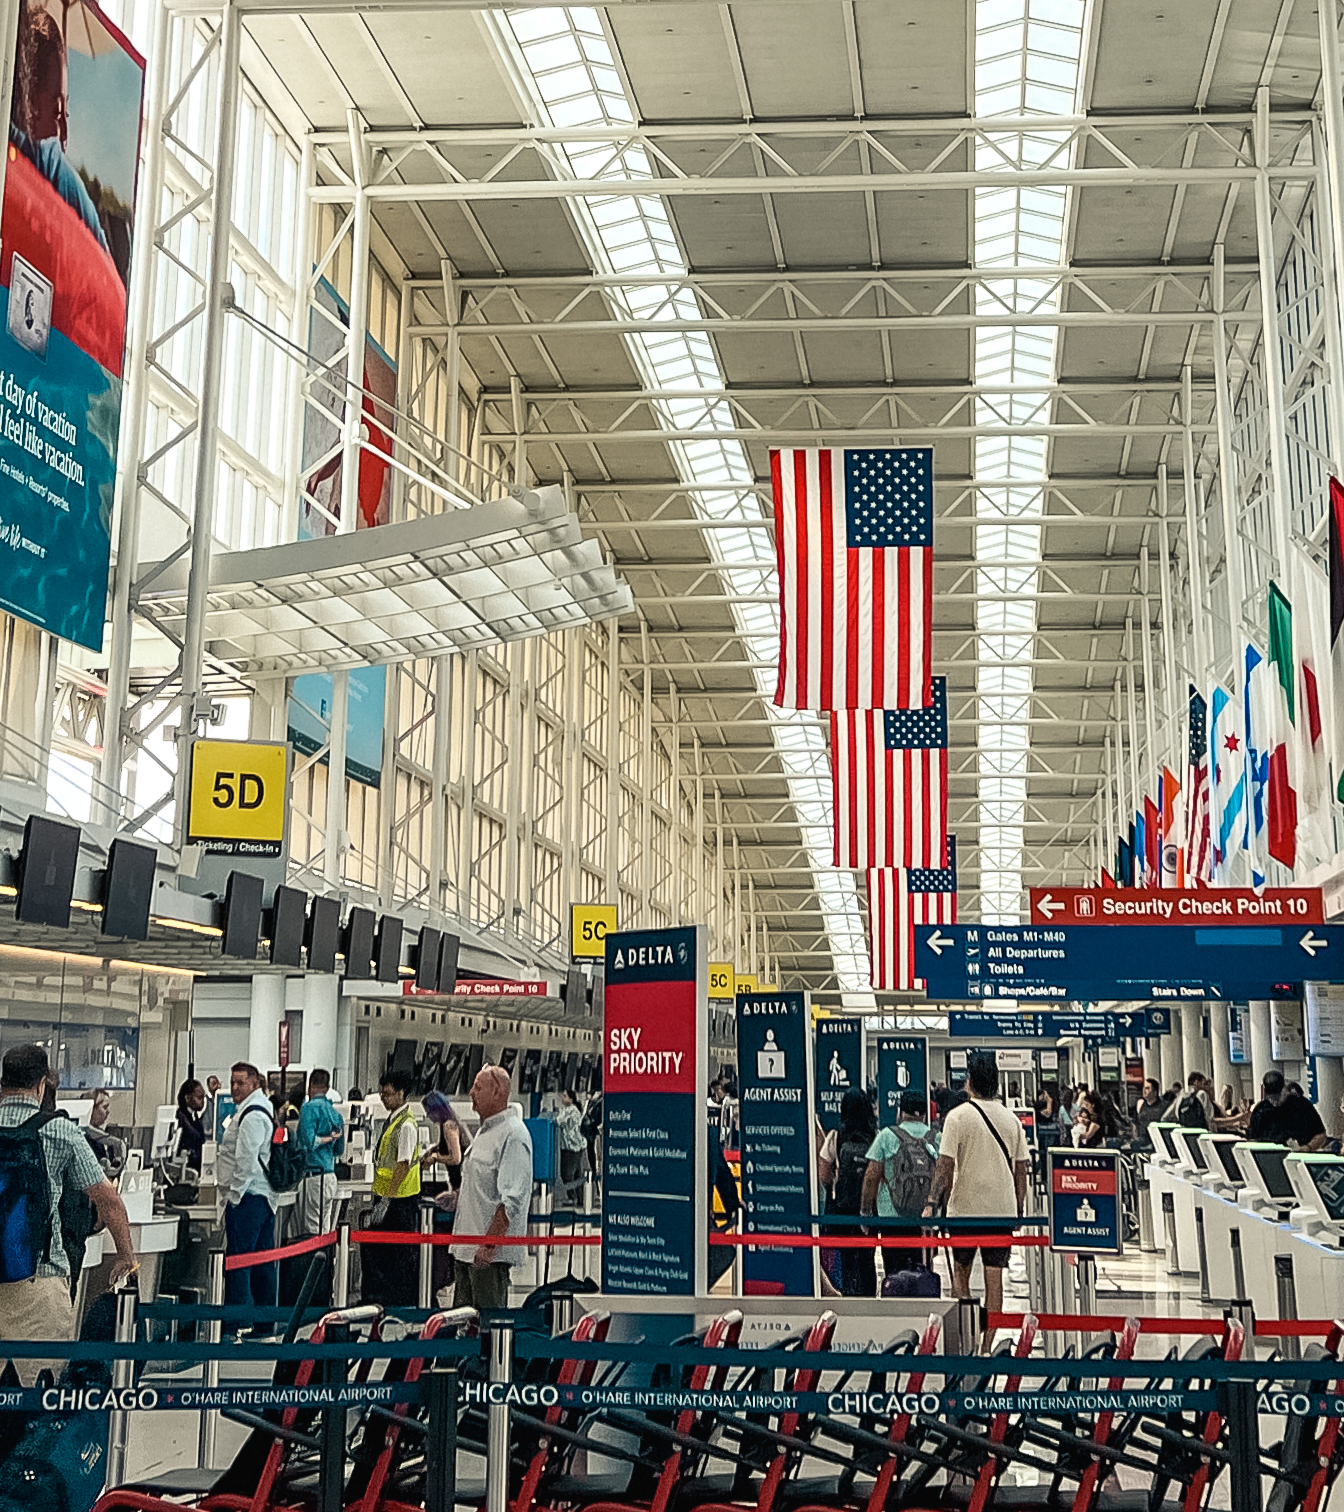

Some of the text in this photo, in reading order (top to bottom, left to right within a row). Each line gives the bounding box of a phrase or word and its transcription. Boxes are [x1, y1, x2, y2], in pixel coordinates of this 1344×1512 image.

[6, 374, 26, 414] day
[25, 391, 38, 418] of
[37, 401, 77, 446] vacation
[4, 409, 24, 446] feel
[24, 421, 44, 459] like
[44, 442, 85, 487] vacation.
[212, 771, 265, 810] 5D
[1102, 897, 1308, 919] Security Check Point 10
[582, 920, 608, 941] 5C
[987, 930, 1019, 942] Gates
[628, 945, 674, 967] DELTA
[987, 946, 1066, 960] All Departures
[987, 962, 1024, 975] Toilets
[710, 974, 728, 988] 5C
[474, 983, 501, 994] Check
[503, 983, 525, 994] Point
[528, 983, 538, 994] 10
[1151, 986, 1205, 997] Stairs Down
[753, 1001, 788, 1015] DELTA
[828, 1022, 852, 1034] DELTA
[609, 1027, 642, 1050] SKY
[889, 1041, 915, 1050] DELTA
[609, 1051, 684, 1076] PRIORITY
[743, 1088, 802, 1103] AGENT ASSIST
[1072, 1159, 1099, 1168] DELTA
[1061, 1181, 1098, 1191] PRIORITY
[1063, 1226, 1110, 1236] AGENT ASSIST
[42, 1388, 159, 1411] CHICAGO
[181, 1386, 393, 1405] O'HARE INTERNATIONAL AIRPORT
[581, 1390, 631, 1405] O'HARE
[634, 1391, 739, 1408] INTERNATIONAL
[742, 1394, 798, 1409] AIRPORT
[827, 1393, 940, 1414] CHICAGO
[964, 1394, 1013, 1410] O'HARE
[1017, 1393, 1124, 1410] INTERNATIONAL
[1127, 1393, 1184, 1409] AIRPORT
